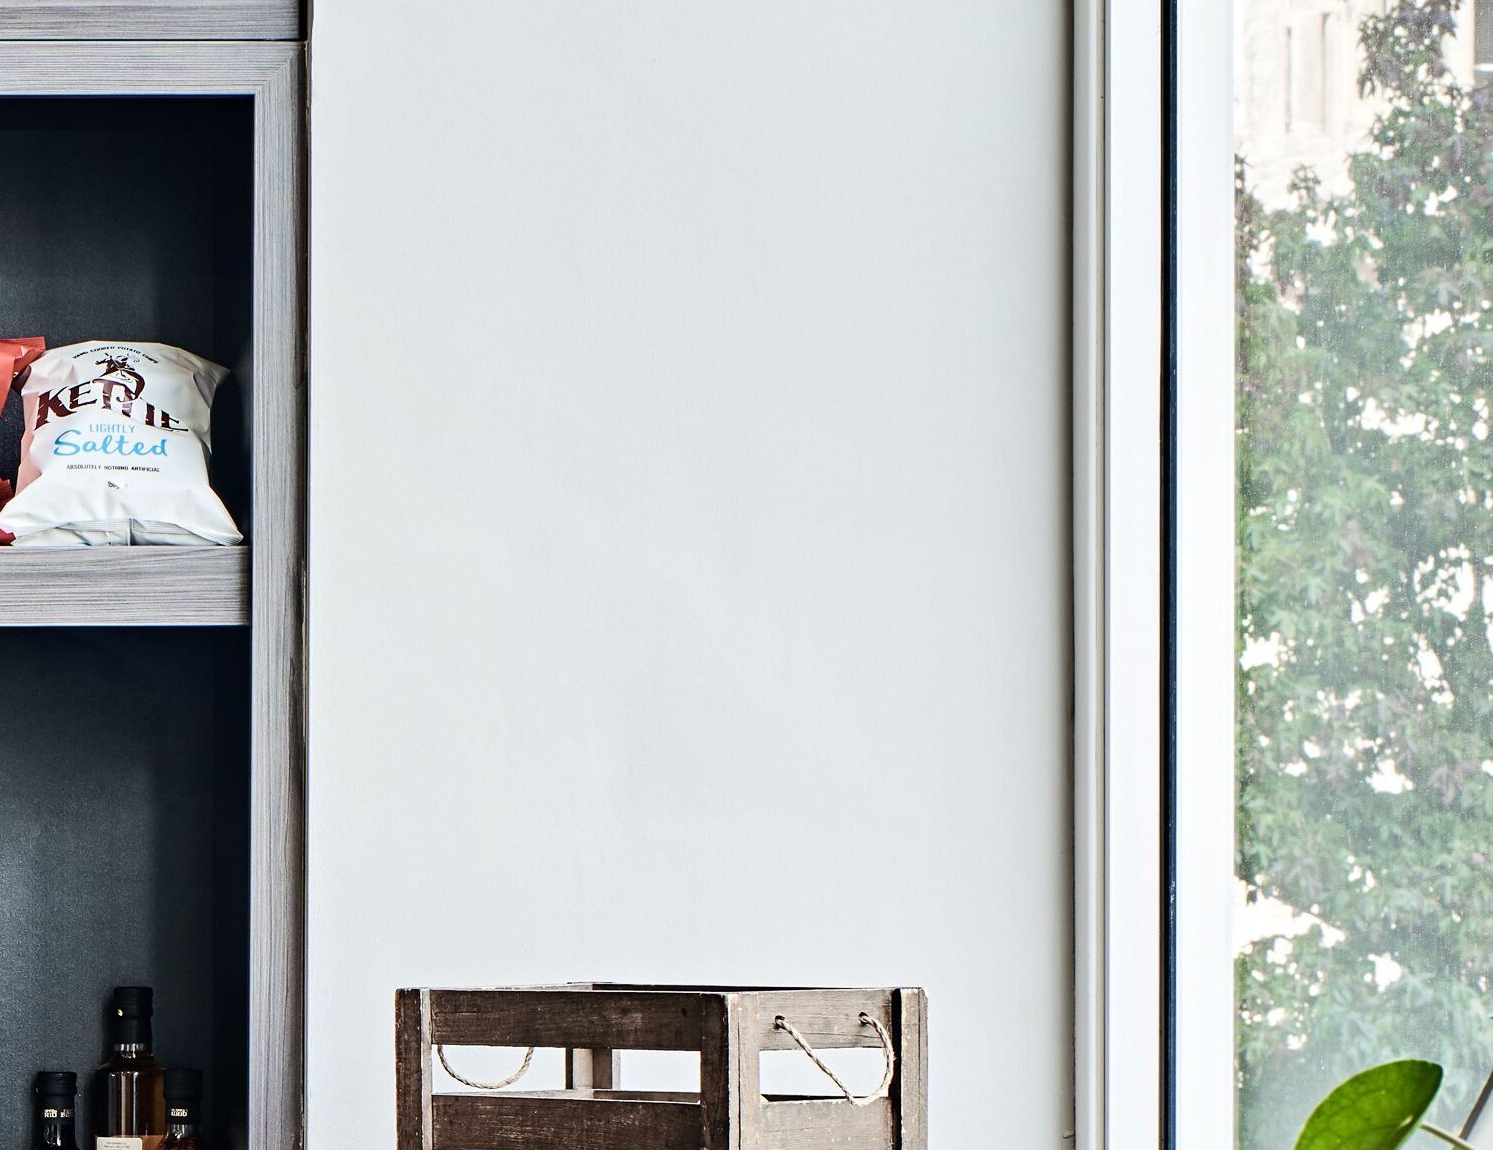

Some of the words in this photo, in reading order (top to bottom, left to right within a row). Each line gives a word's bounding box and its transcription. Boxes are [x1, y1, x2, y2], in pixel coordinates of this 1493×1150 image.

[34, 365, 189, 431] KETTLE
[89, 423, 136, 433] LIGHTLY
[53, 429, 169, 457] Salted
